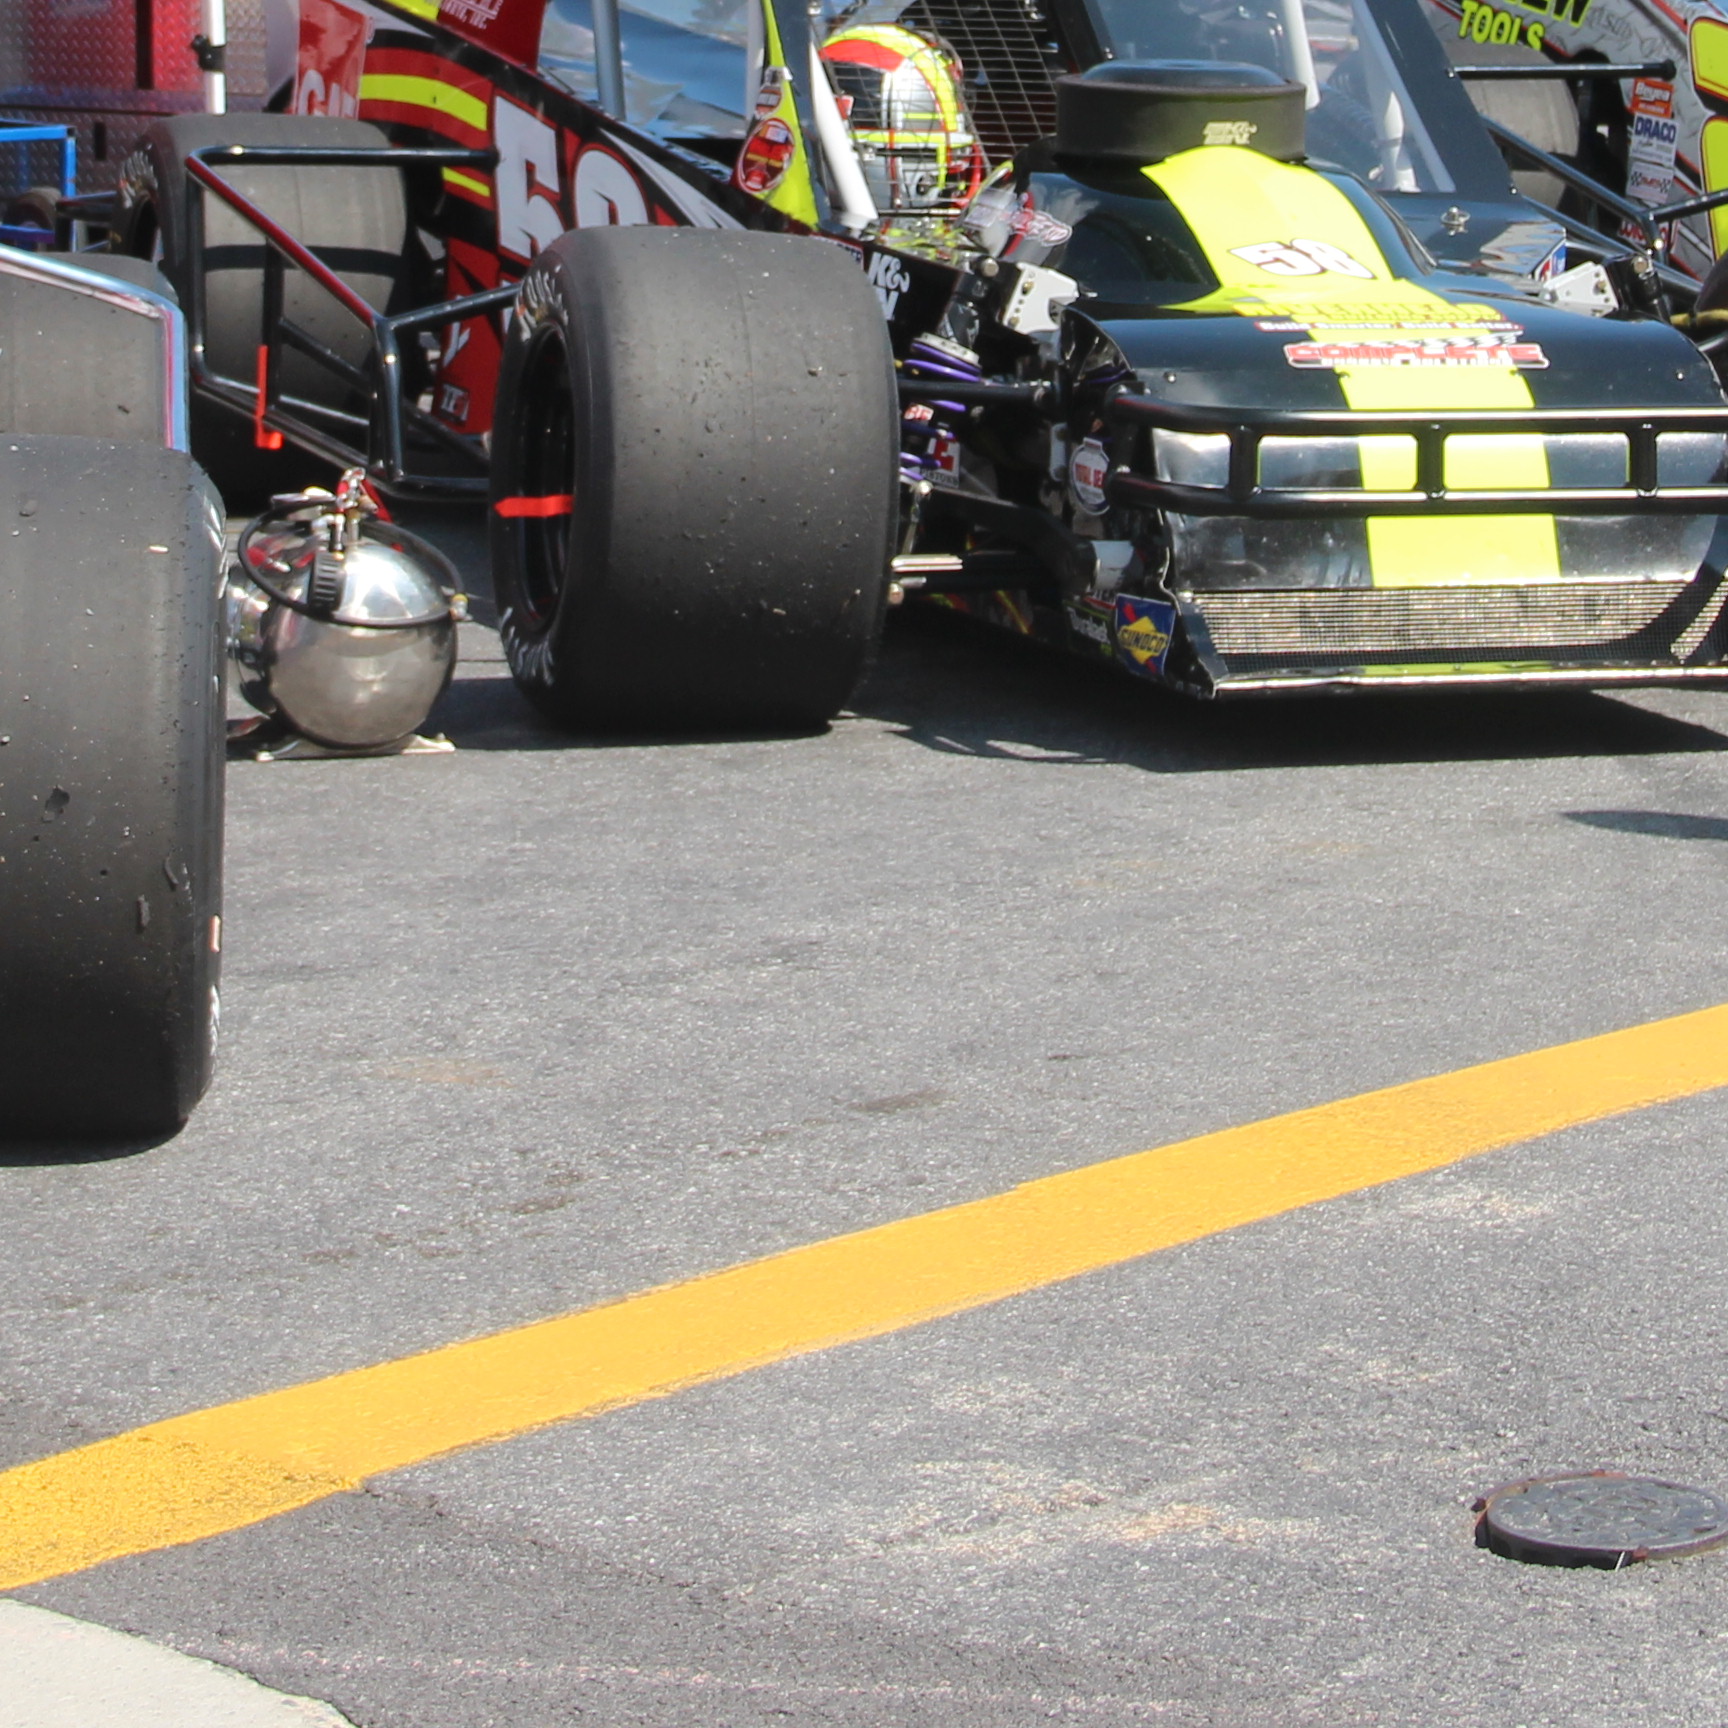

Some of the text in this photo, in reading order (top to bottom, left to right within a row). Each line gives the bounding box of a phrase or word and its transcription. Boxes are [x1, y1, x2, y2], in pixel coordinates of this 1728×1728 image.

[1634, 116, 1677, 144] DRACO
[1229, 240, 1376, 281] 58
[1118, 625, 1167, 654] SUNOCO
